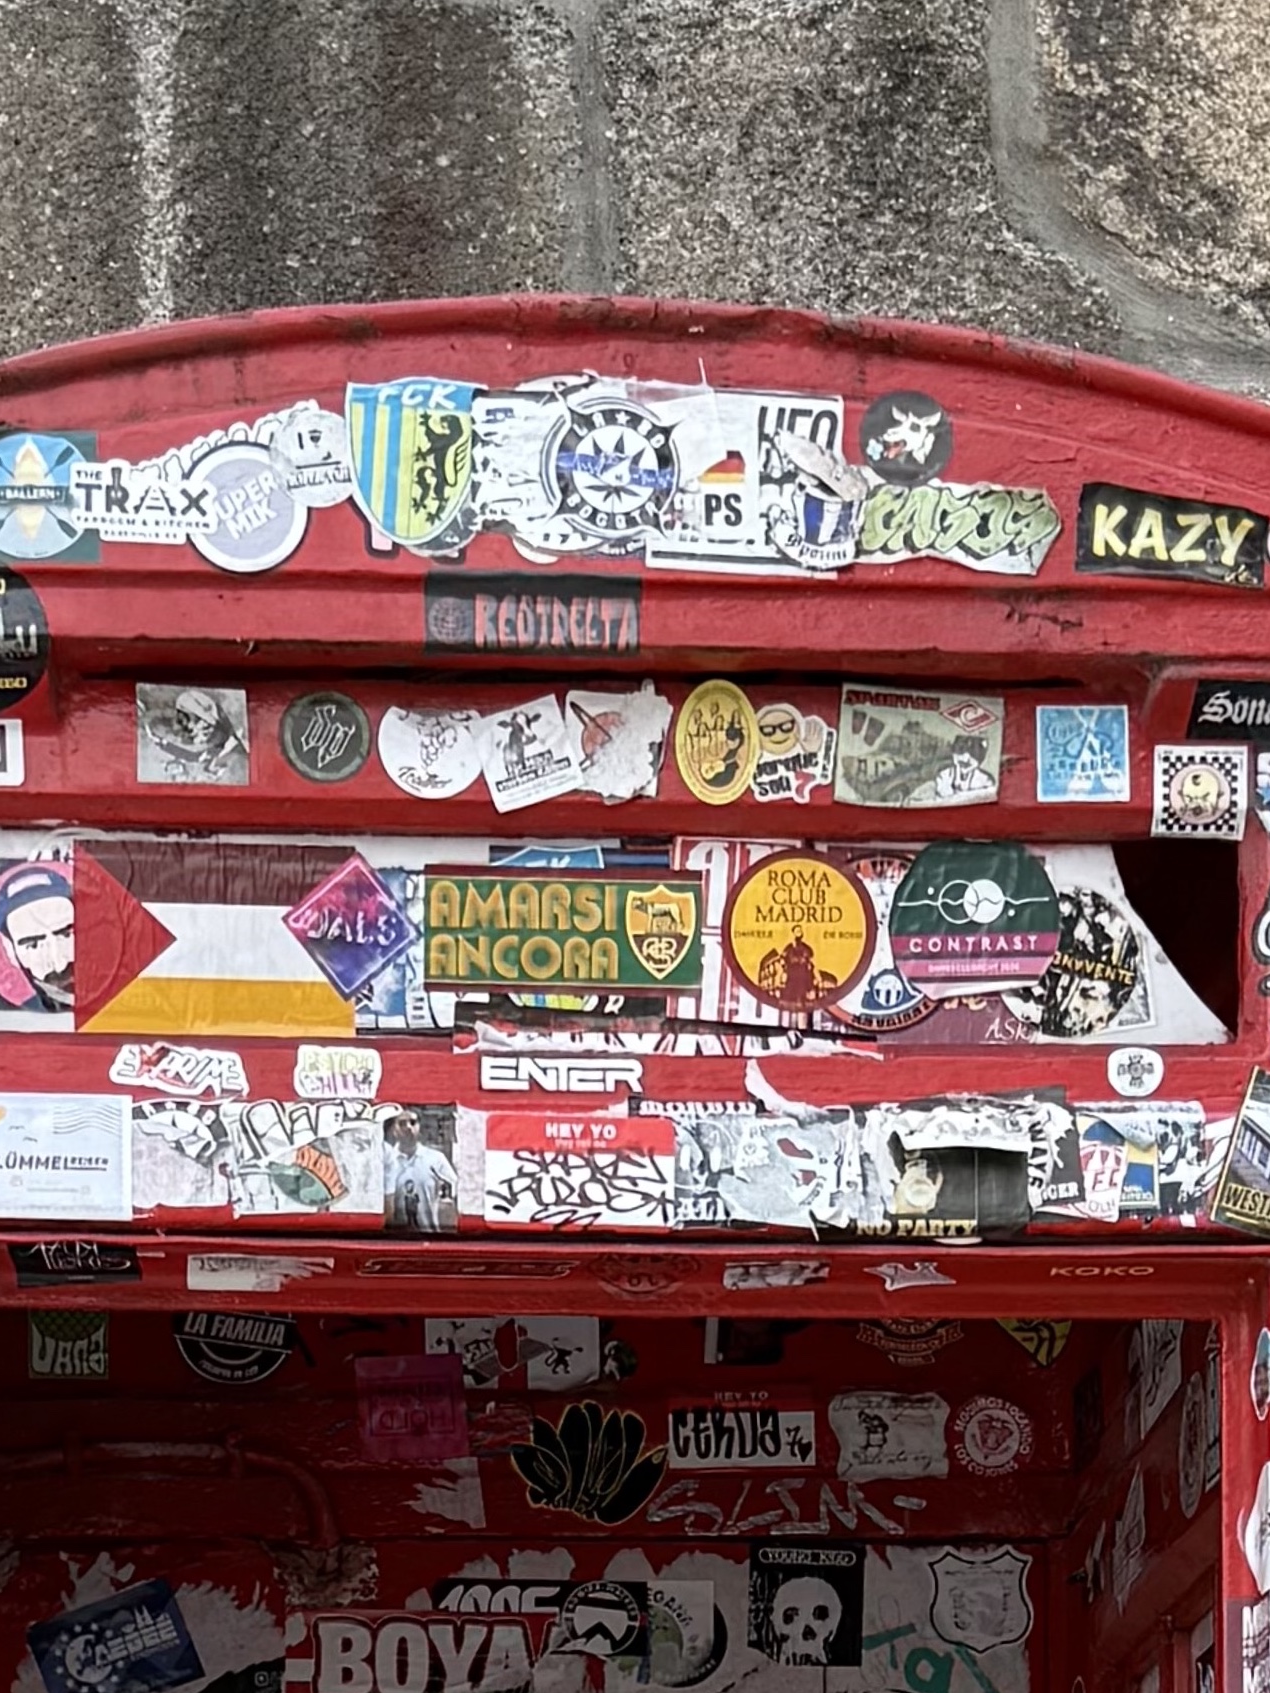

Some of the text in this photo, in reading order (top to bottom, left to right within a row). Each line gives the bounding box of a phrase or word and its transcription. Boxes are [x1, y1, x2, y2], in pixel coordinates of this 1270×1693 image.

[76, 470, 103, 483] THE
[704, 493, 742, 527] PS
[1092, 503, 1255, 567] KAZY
[767, 869, 832, 888] ROMA
[429, 880, 619, 932] AMARSI
[771, 887, 827, 906] CLUB
[753, 904, 844, 923] MADRID
[909, 934, 1038, 955] CONTRAST
[429, 933, 620, 981] ANCORA
[485, 1057, 643, 1093] ENTER
[545, 1121, 617, 1139] HEY YO
[857, 1219, 979, 1238] NO PARTY
[1050, 1266, 1155, 1278] KOKO
[184, 1311, 288, 1348] LA FAMILIA
